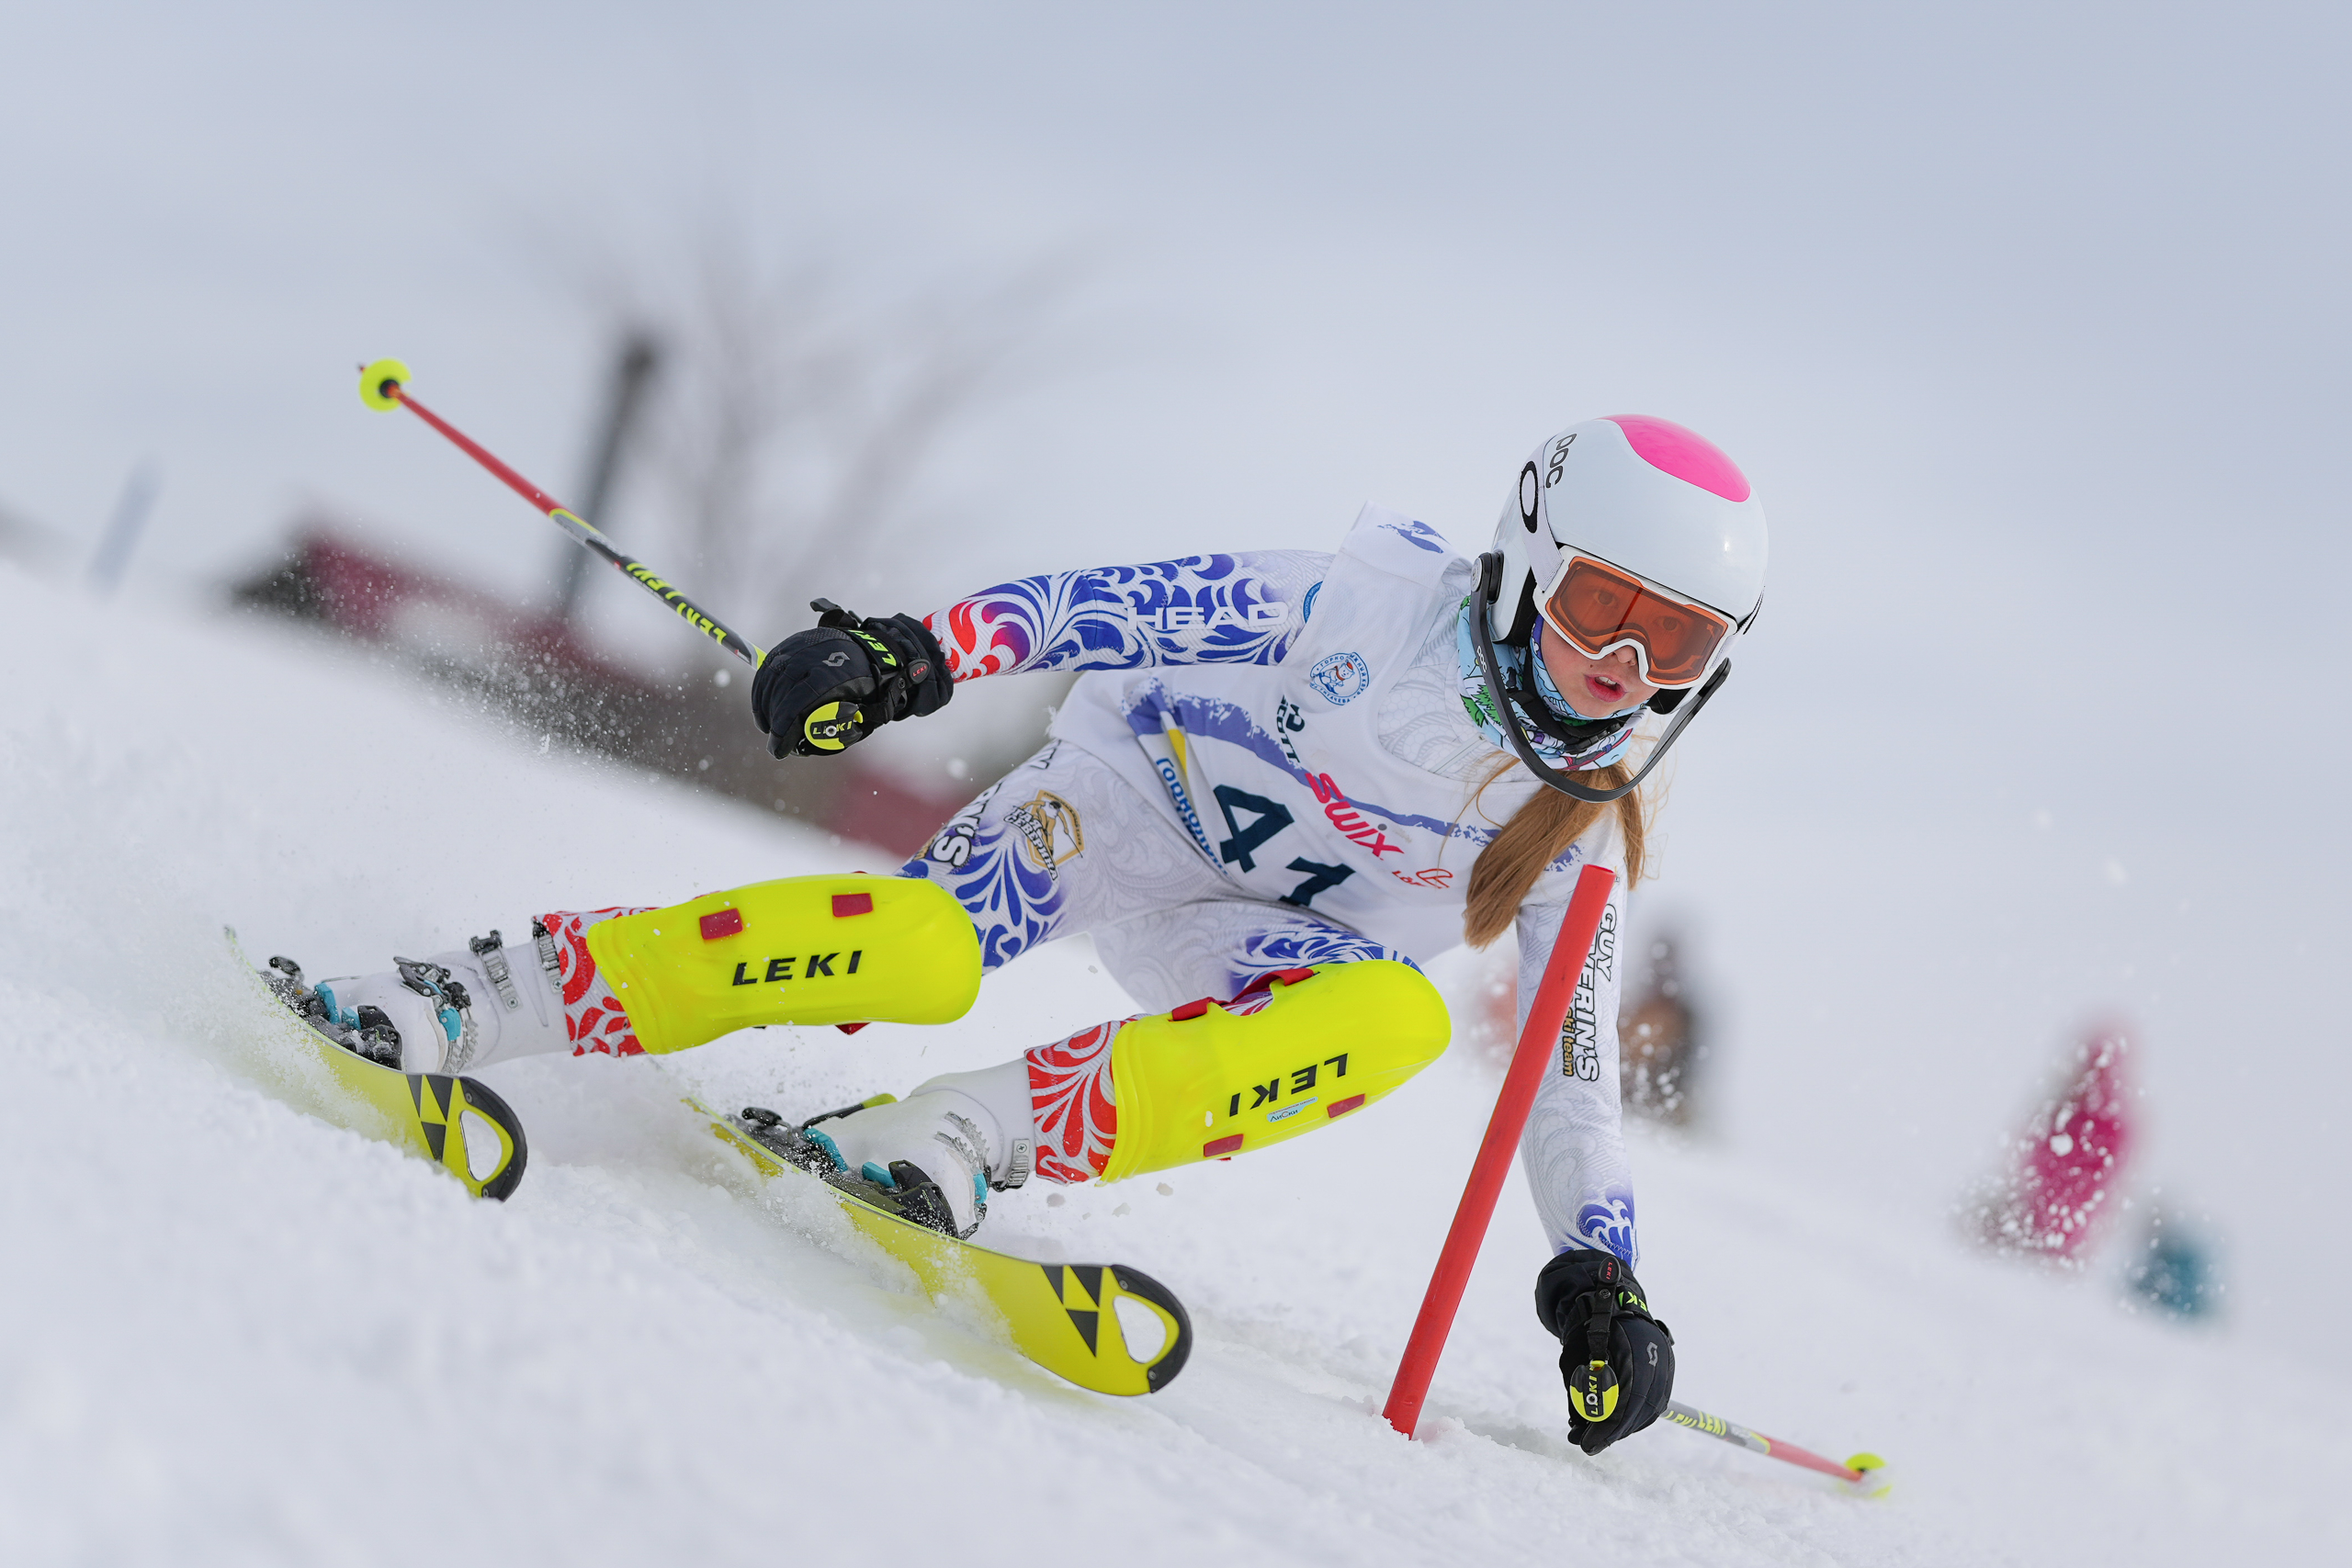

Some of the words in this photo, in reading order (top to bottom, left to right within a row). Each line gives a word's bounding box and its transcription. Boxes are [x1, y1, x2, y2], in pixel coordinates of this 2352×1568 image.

[1127, 602, 1288, 630] HEAD
[848, 629, 897, 667] LEKI
[912, 665, 927, 678] LEKI
[812, 721, 852, 735] LKI
[1305, 773, 1405, 861] SWIX
[1213, 784, 1356, 907] 41
[1597, 903, 1617, 982] GUY
[732, 950, 863, 987] LEKI
[1563, 1035, 1575, 1077] team
[1229, 1053, 1348, 1117] LEKI
[1618, 1291, 1648, 1313] EKI
[1589, 1375, 1598, 1416] LKI
